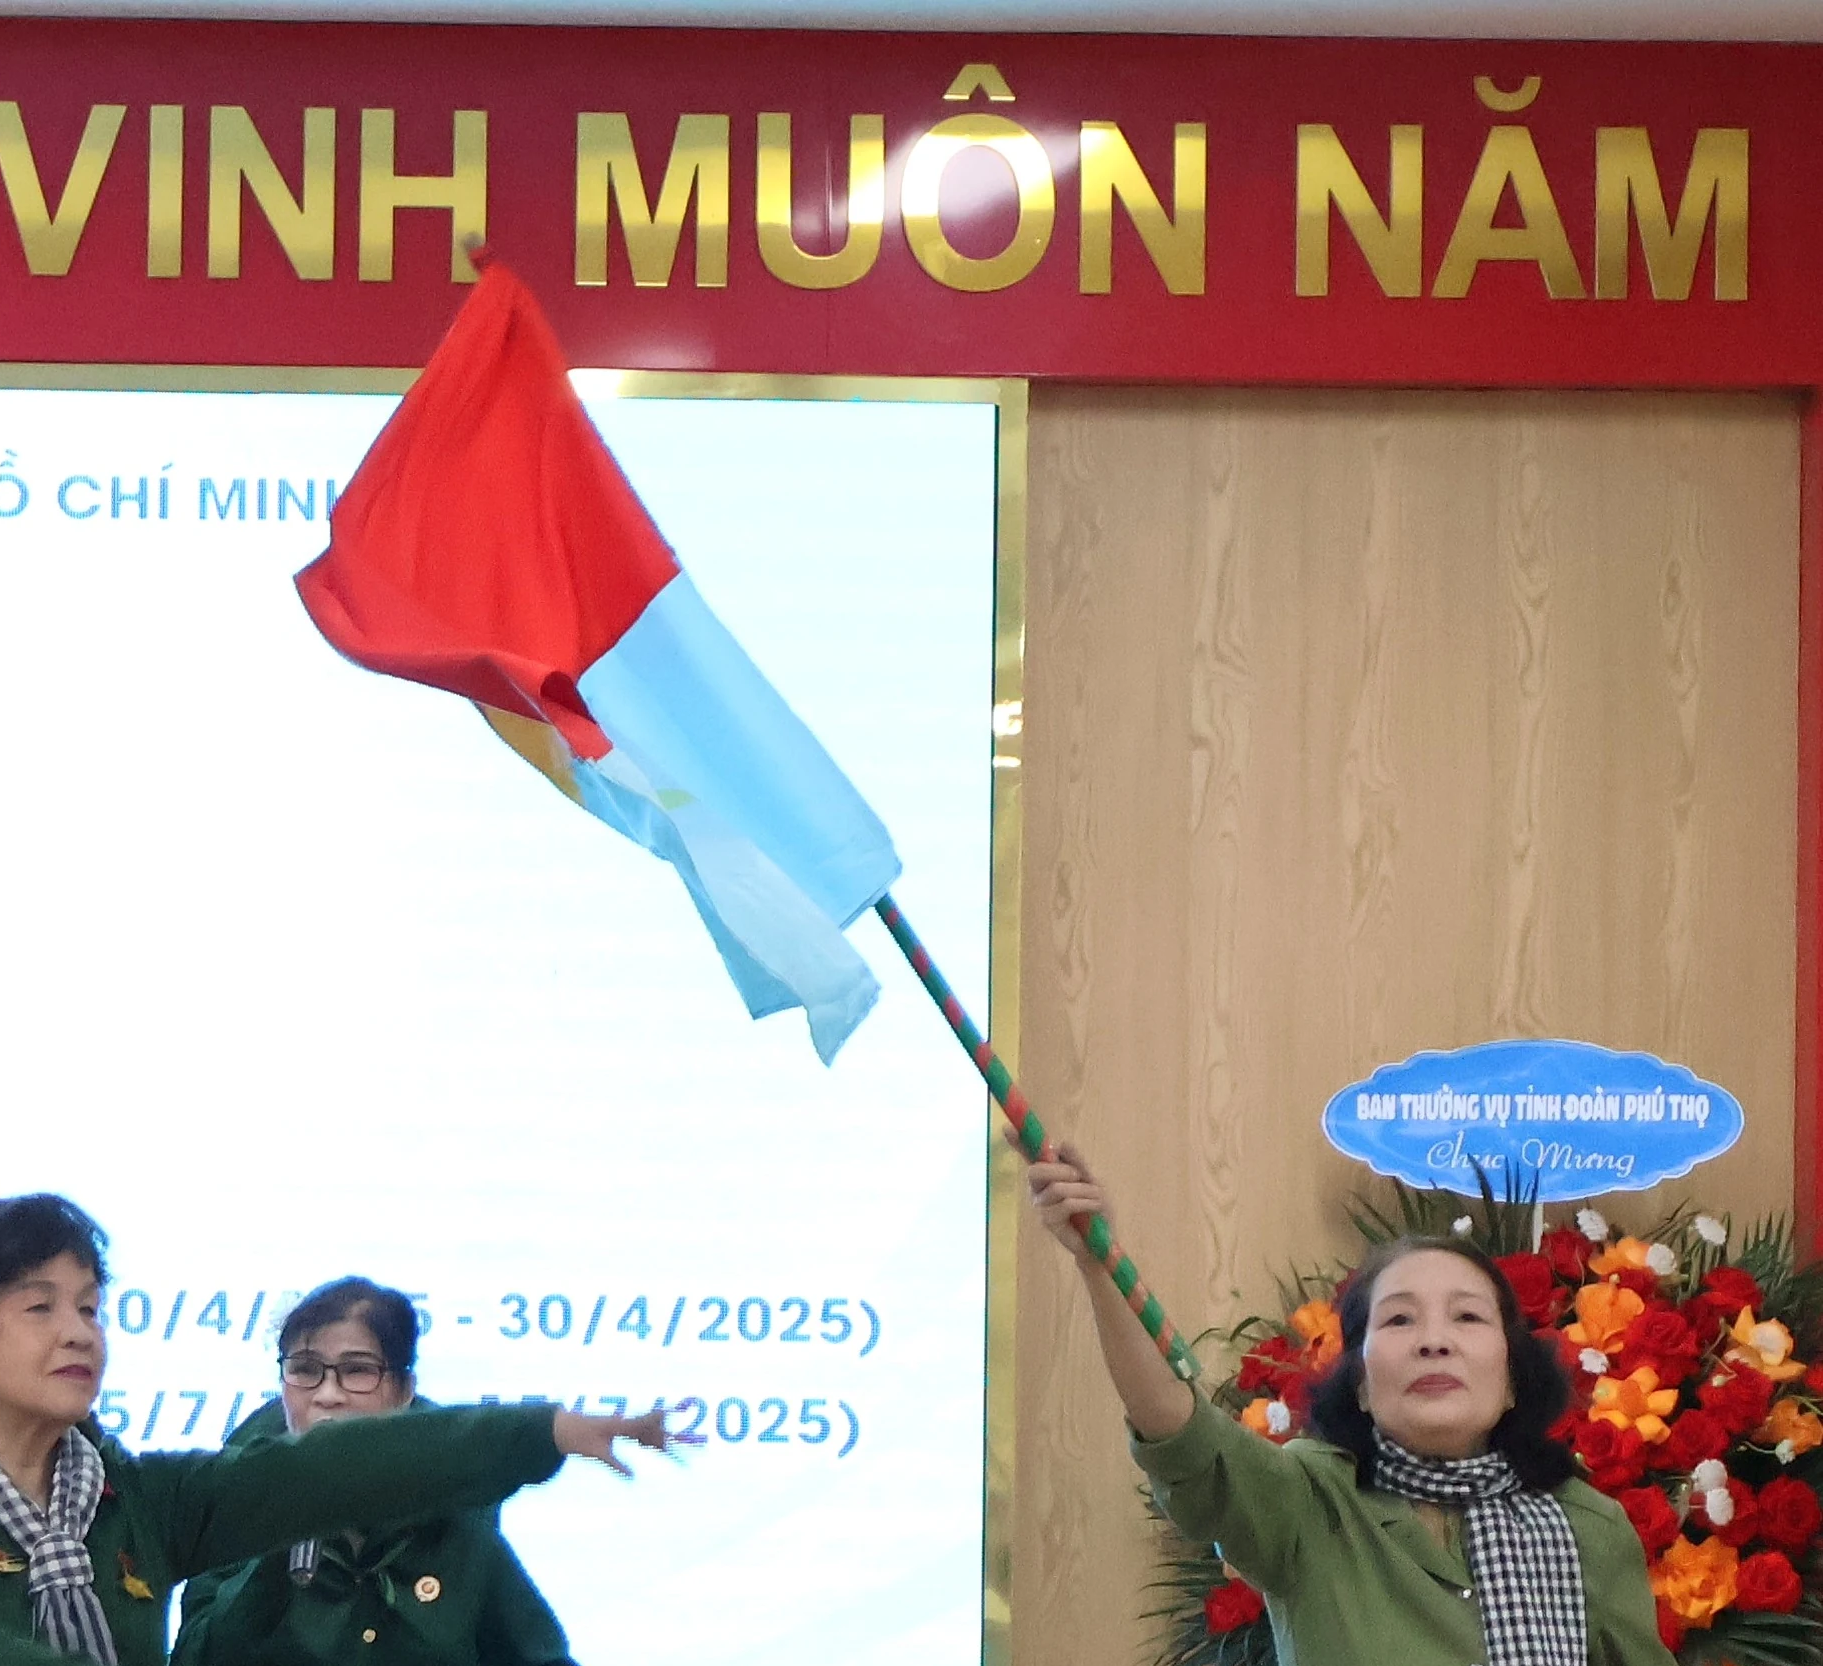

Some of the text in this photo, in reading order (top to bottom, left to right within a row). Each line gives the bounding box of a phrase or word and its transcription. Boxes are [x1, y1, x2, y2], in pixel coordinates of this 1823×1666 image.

[575, 63, 1208, 295] MUÔN
[1295, 74, 1750, 301] NĂM
[56, 462, 174, 521] CHÍ
[1356, 1093, 1397, 1121] BAN
[1484, 1093, 1512, 1129] VỤ
[1563, 1085, 1621, 1122] ĐOÀN
[1623, 1084, 1666, 1122] PHÚ
[1668, 1094, 1711, 1130] THỌ
[498, 1292, 882, 1358] 30/4/2025)
